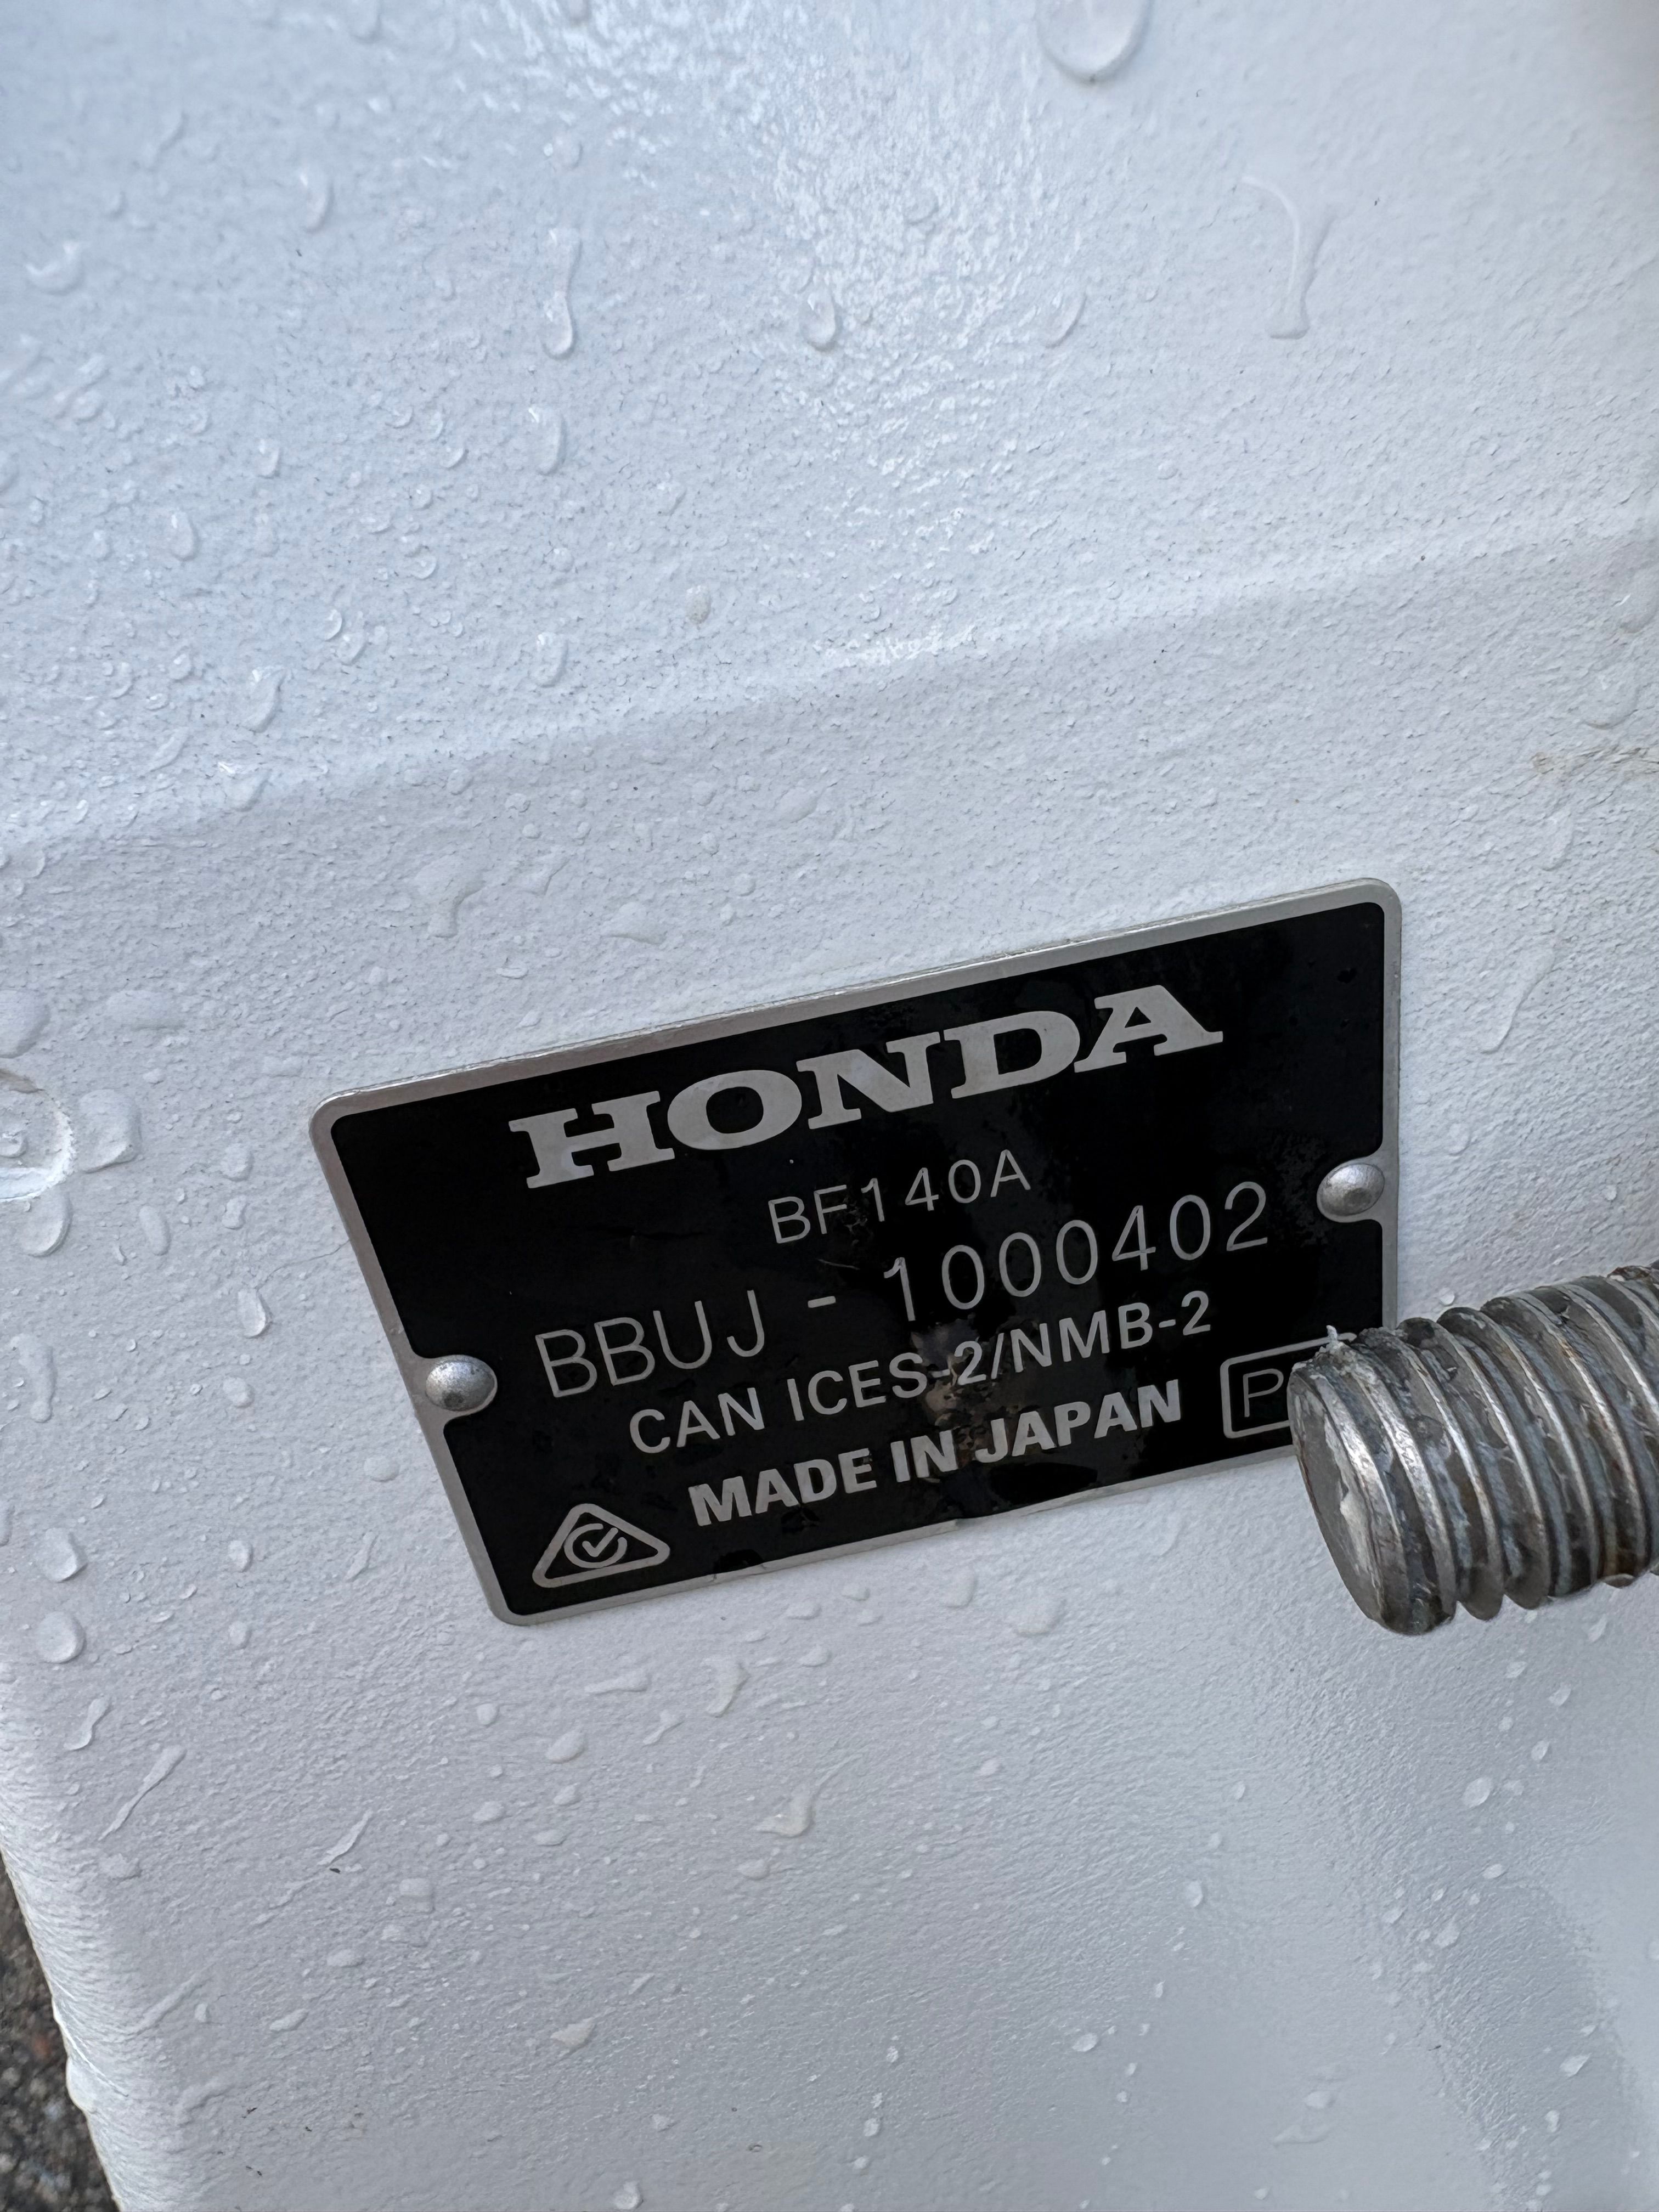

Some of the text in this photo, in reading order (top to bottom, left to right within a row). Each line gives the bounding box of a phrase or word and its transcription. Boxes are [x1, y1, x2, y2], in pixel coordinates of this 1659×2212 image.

[509, 985, 1223, 1188] HONDA
[769, 1150, 1030, 1244] BF140A
[536, 1181, 1265, 1397] BBUJ - 1000402
[630, 1291, 1210, 1453] CAN ICES-2/NMB-2
[689, 1380, 1180, 1526] MADE IN JAPAN
